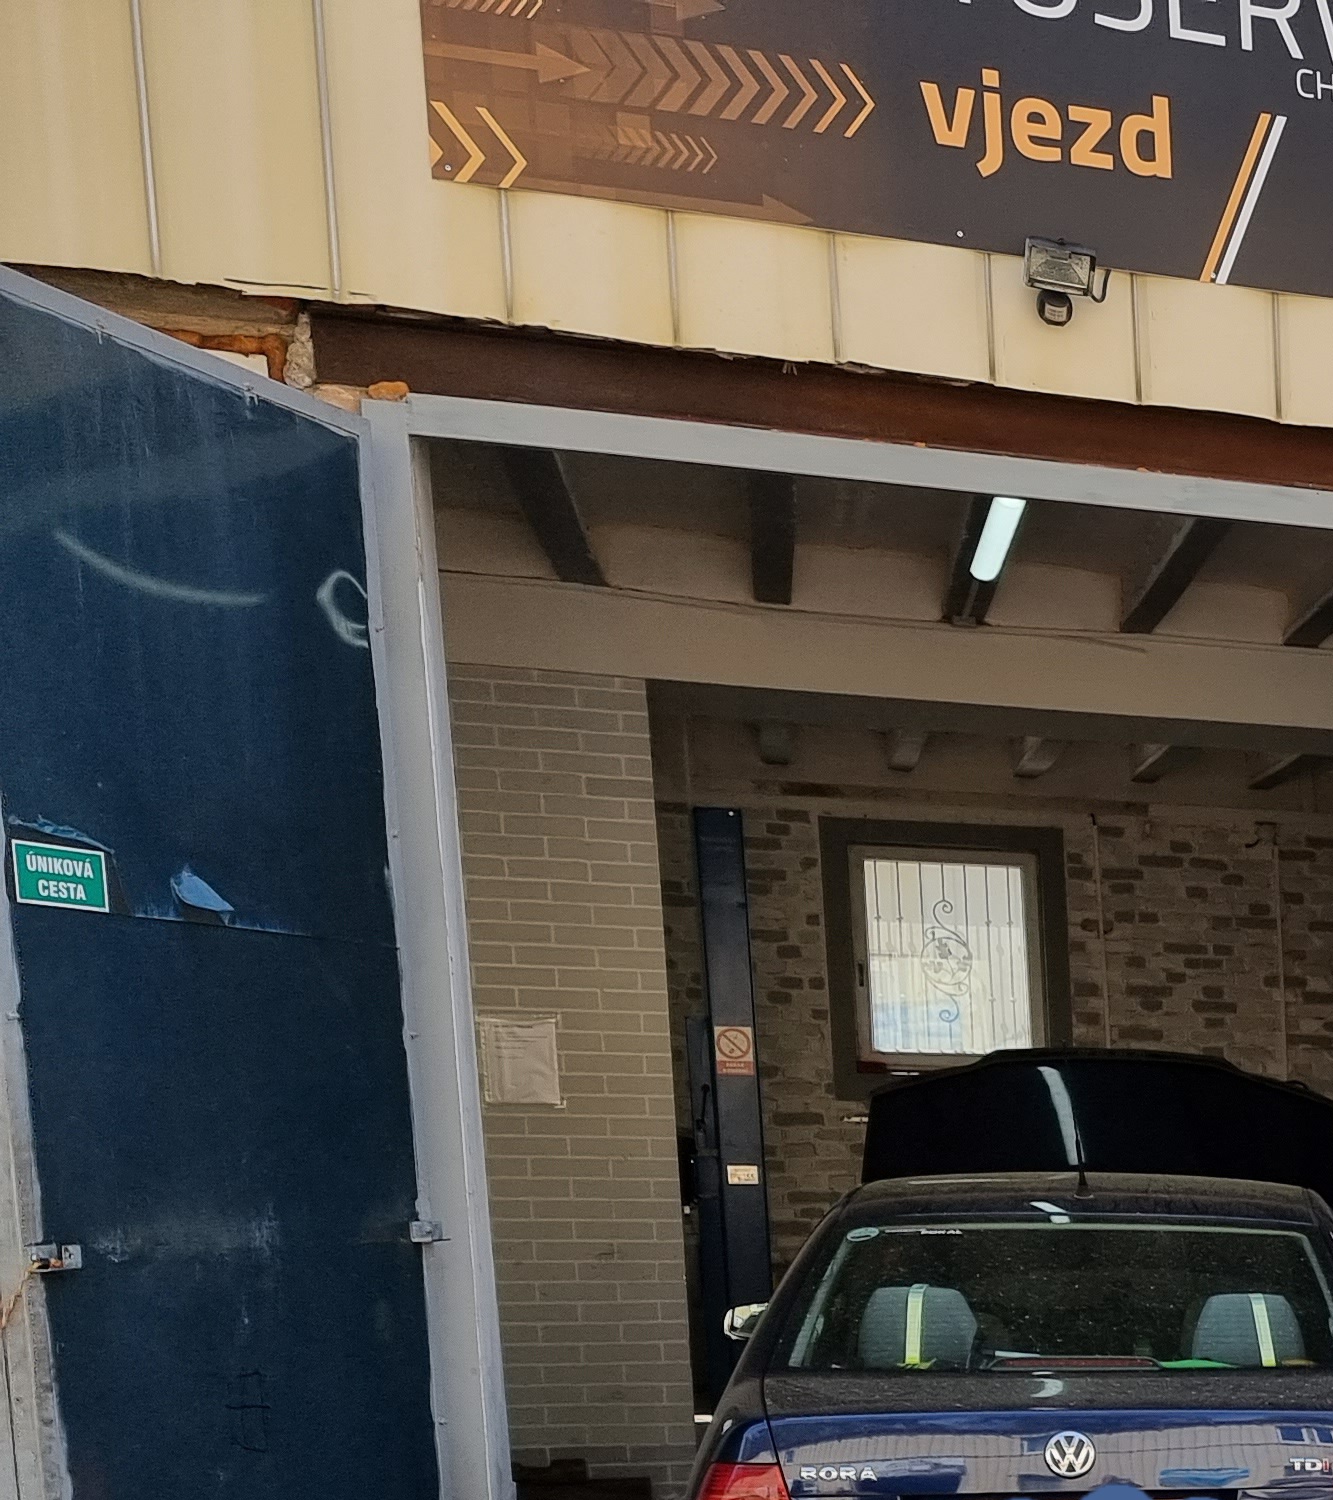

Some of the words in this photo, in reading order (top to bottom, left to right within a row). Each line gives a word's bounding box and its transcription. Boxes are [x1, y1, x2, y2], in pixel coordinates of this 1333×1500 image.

[920, 68, 1173, 179] vjezd
[26, 850, 94, 879] ÚNIKOVÁ
[37, 879, 87, 901] CESTA
[1289, 1457, 1330, 1473] TDI
